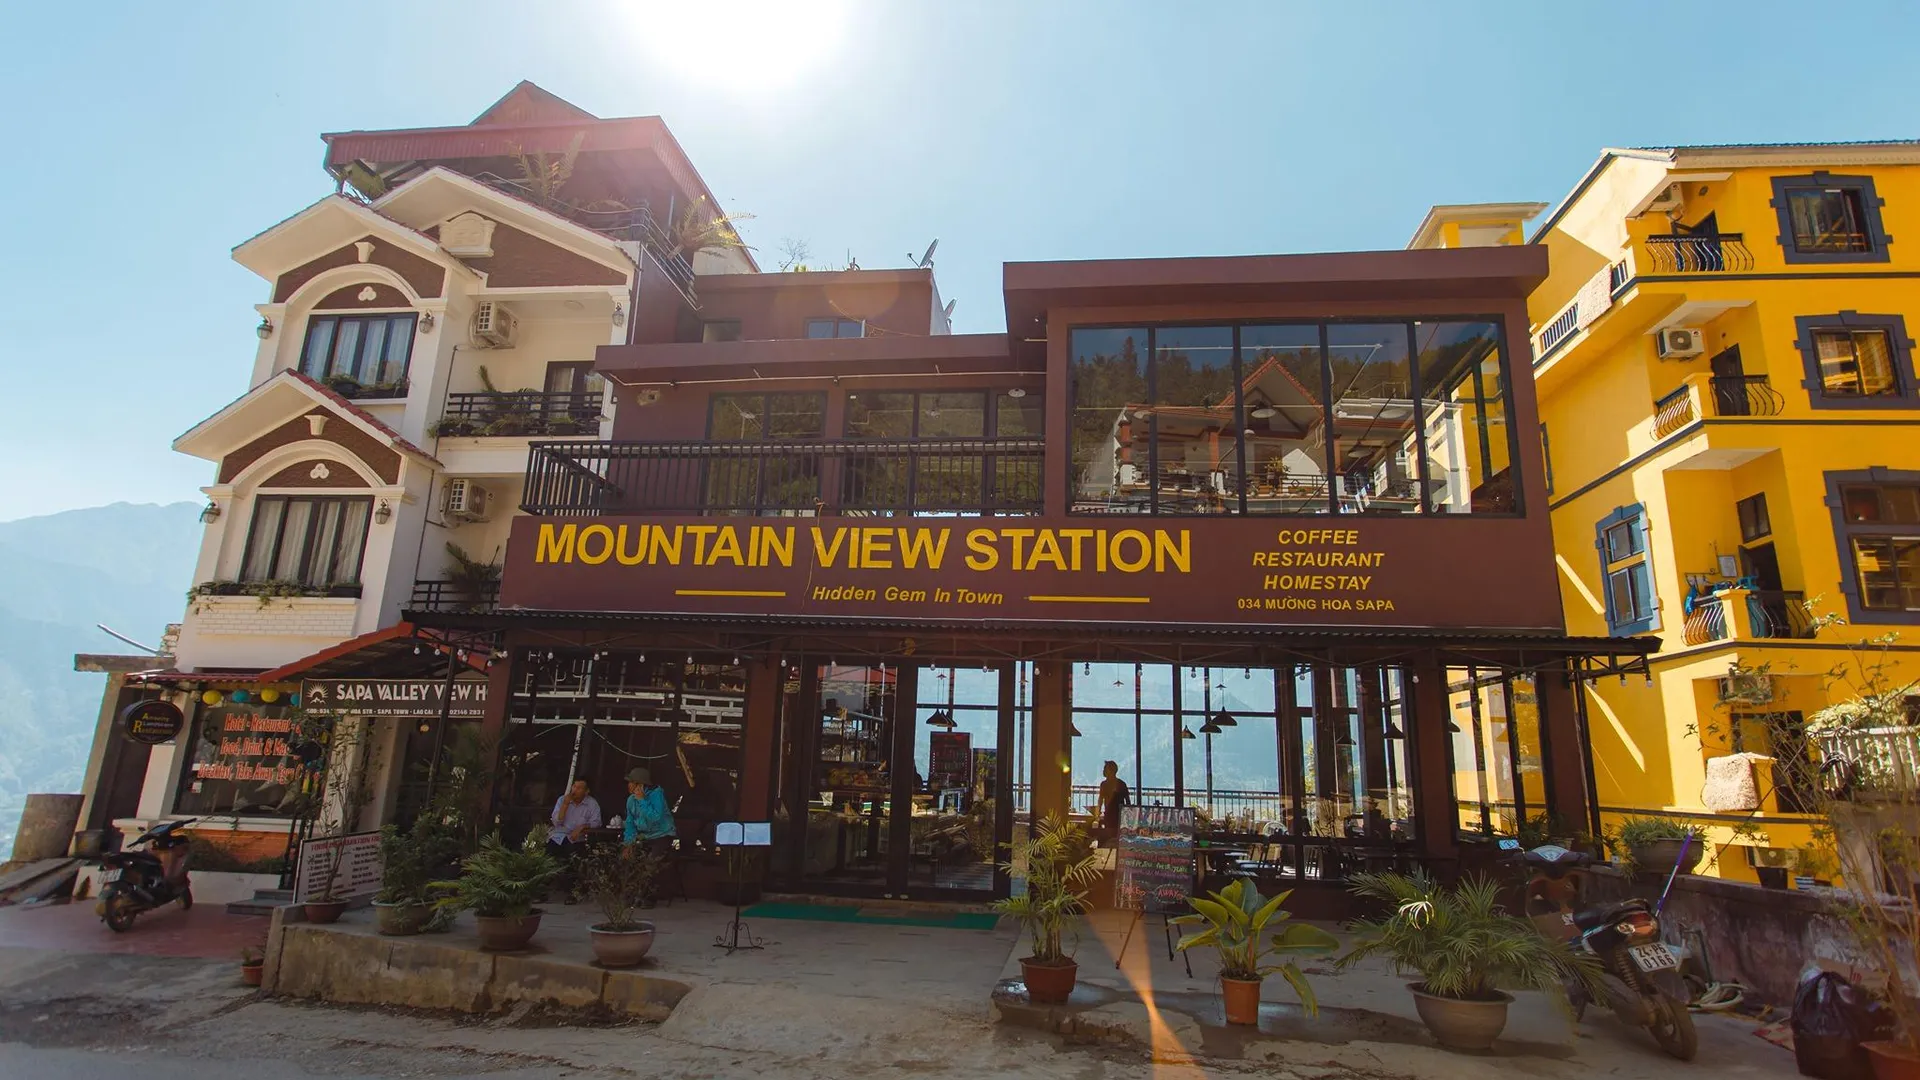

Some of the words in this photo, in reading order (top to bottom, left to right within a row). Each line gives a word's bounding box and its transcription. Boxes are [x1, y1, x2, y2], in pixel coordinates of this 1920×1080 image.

[1278, 530, 1359, 545] COFFEE
[535, 524, 796, 568] MOUNTAIN
[811, 526, 951, 569] VIEW
[964, 528, 1192, 573] STATION
[1252, 552, 1385, 567] RESTAURANT
[1264, 575, 1371, 590] HOMESTAY
[812, 585, 876, 602] Hidden
[884, 587, 926, 603] Gem
[934, 588, 951, 603] In
[956, 588, 1004, 605] Town
[1237, 598, 1261, 610] 034
[1321, 599, 1352, 610] HOA
[1355, 599, 1395, 611] SAPA
[336, 684, 374, 701] SAPA
[376, 684, 430, 700] VALLEY
[224, 713, 246, 732] Hotel
[249, 713, 292, 733] Restaurant
[242, 737, 264, 756] Drink
[236, 760, 253, 780] Take
[1643, 954, 1675, 969] 0166
